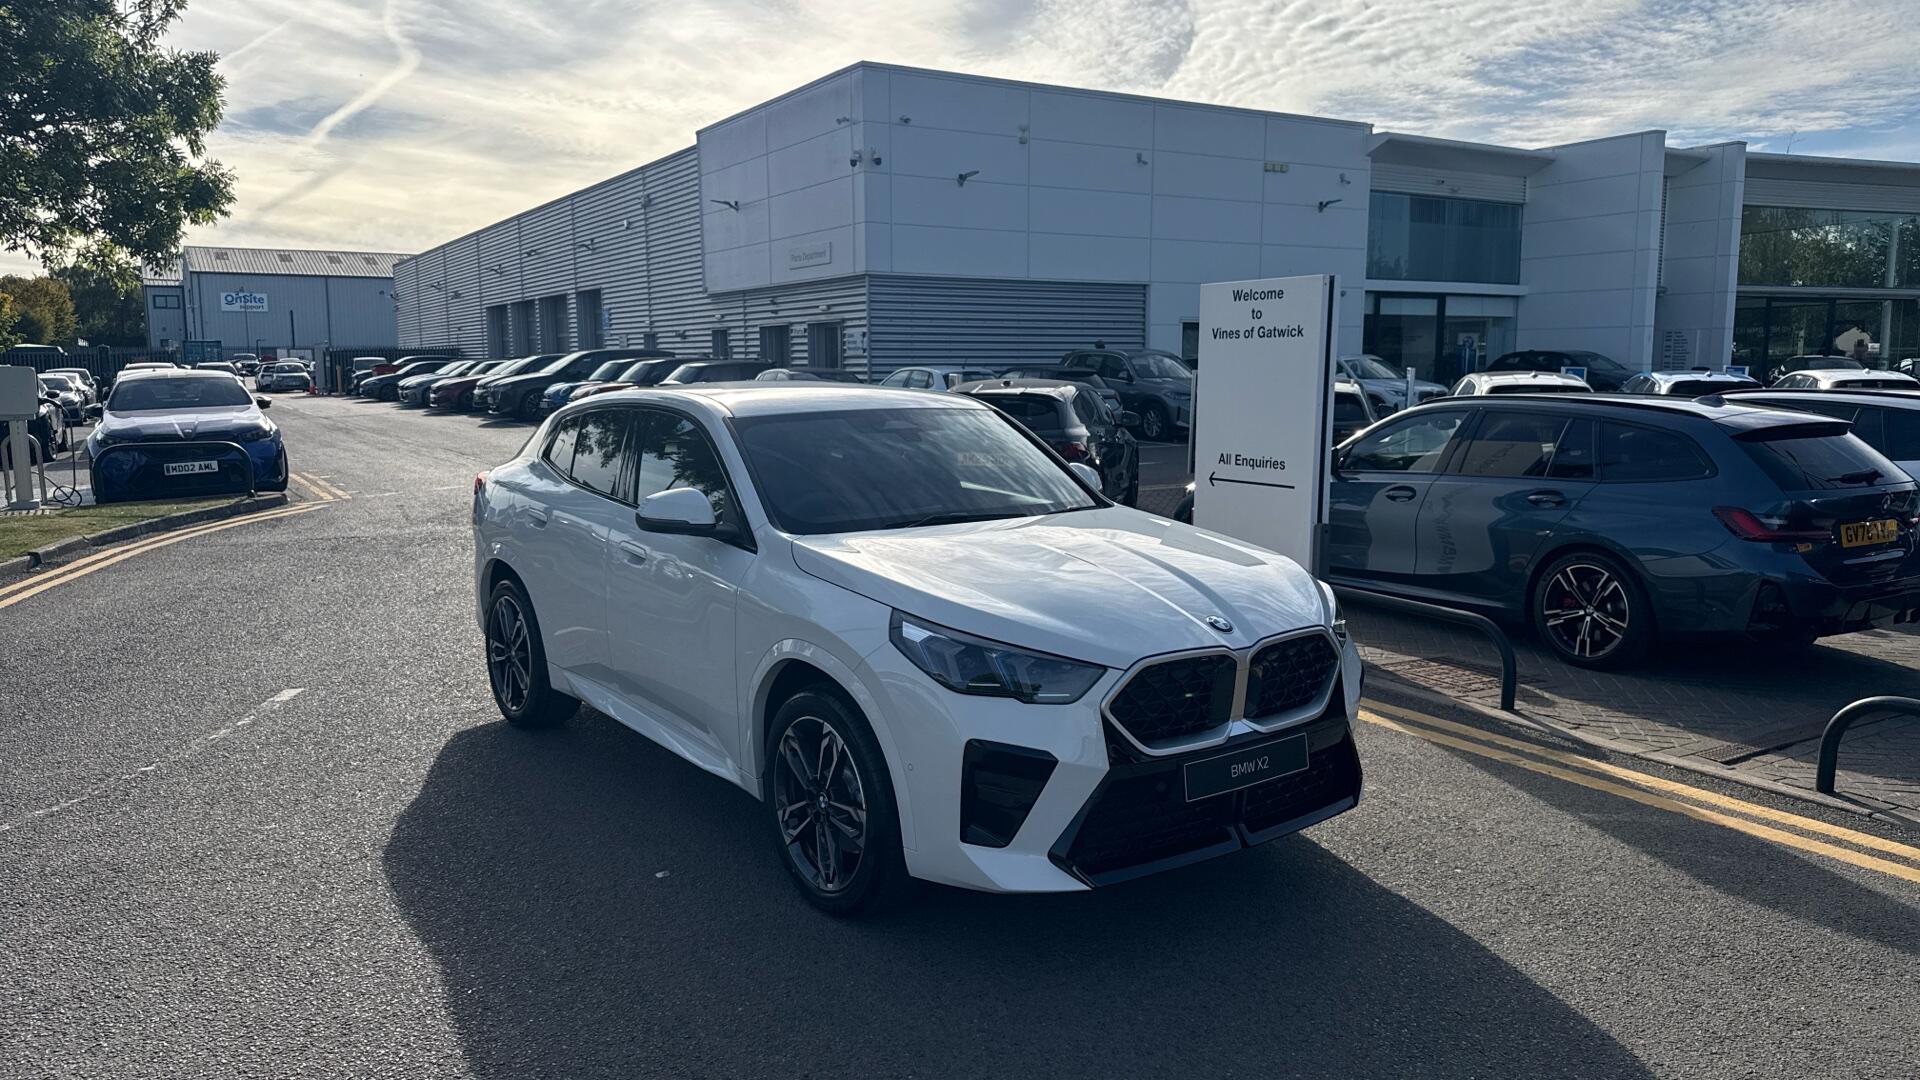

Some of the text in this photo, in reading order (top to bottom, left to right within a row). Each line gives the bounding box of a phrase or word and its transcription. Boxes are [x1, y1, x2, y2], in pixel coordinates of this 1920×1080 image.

[1232, 289, 1284, 302] Welcome
[1251, 308, 1263, 320] to
[1212, 324, 1304, 340] Vines of Gatwick
[1218, 452, 1286, 471] All Enquiries
[1231, 756, 1270, 778] BMW X2
